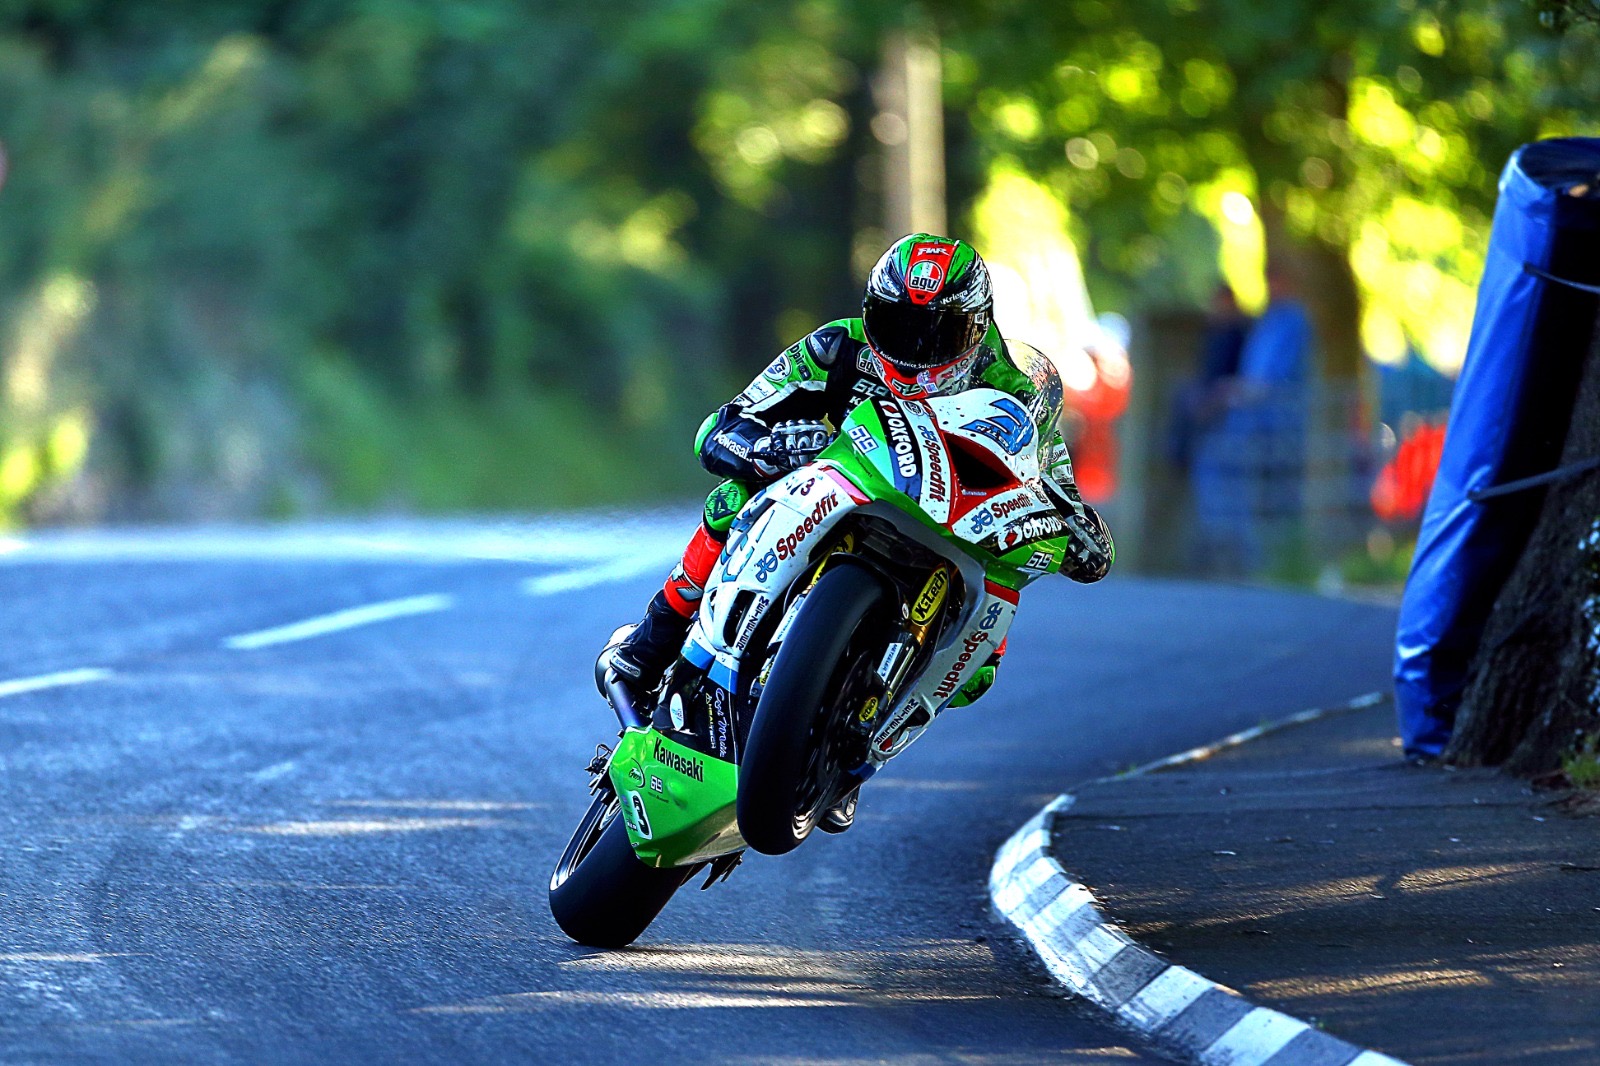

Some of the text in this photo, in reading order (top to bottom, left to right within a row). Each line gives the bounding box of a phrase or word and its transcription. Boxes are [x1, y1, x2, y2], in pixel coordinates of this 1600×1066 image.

[912, 276, 938, 290] agv
[942, 290, 969, 305] Kriega
[880, 351, 899, 364] Accident
[900, 360, 918, 369] Advice
[887, 418, 917, 478] OXFORD
[922, 439, 946, 503] Speedfit
[776, 492, 839, 560] Speedfit
[990, 493, 1034, 519] Speedfit
[1023, 516, 1062, 539] OXFORD
[735, 595, 770, 652] METZELER
[932, 630, 990, 699] Speedfit
[874, 698, 919, 746] METZELER
[653, 737, 704, 783] Kawasaki
